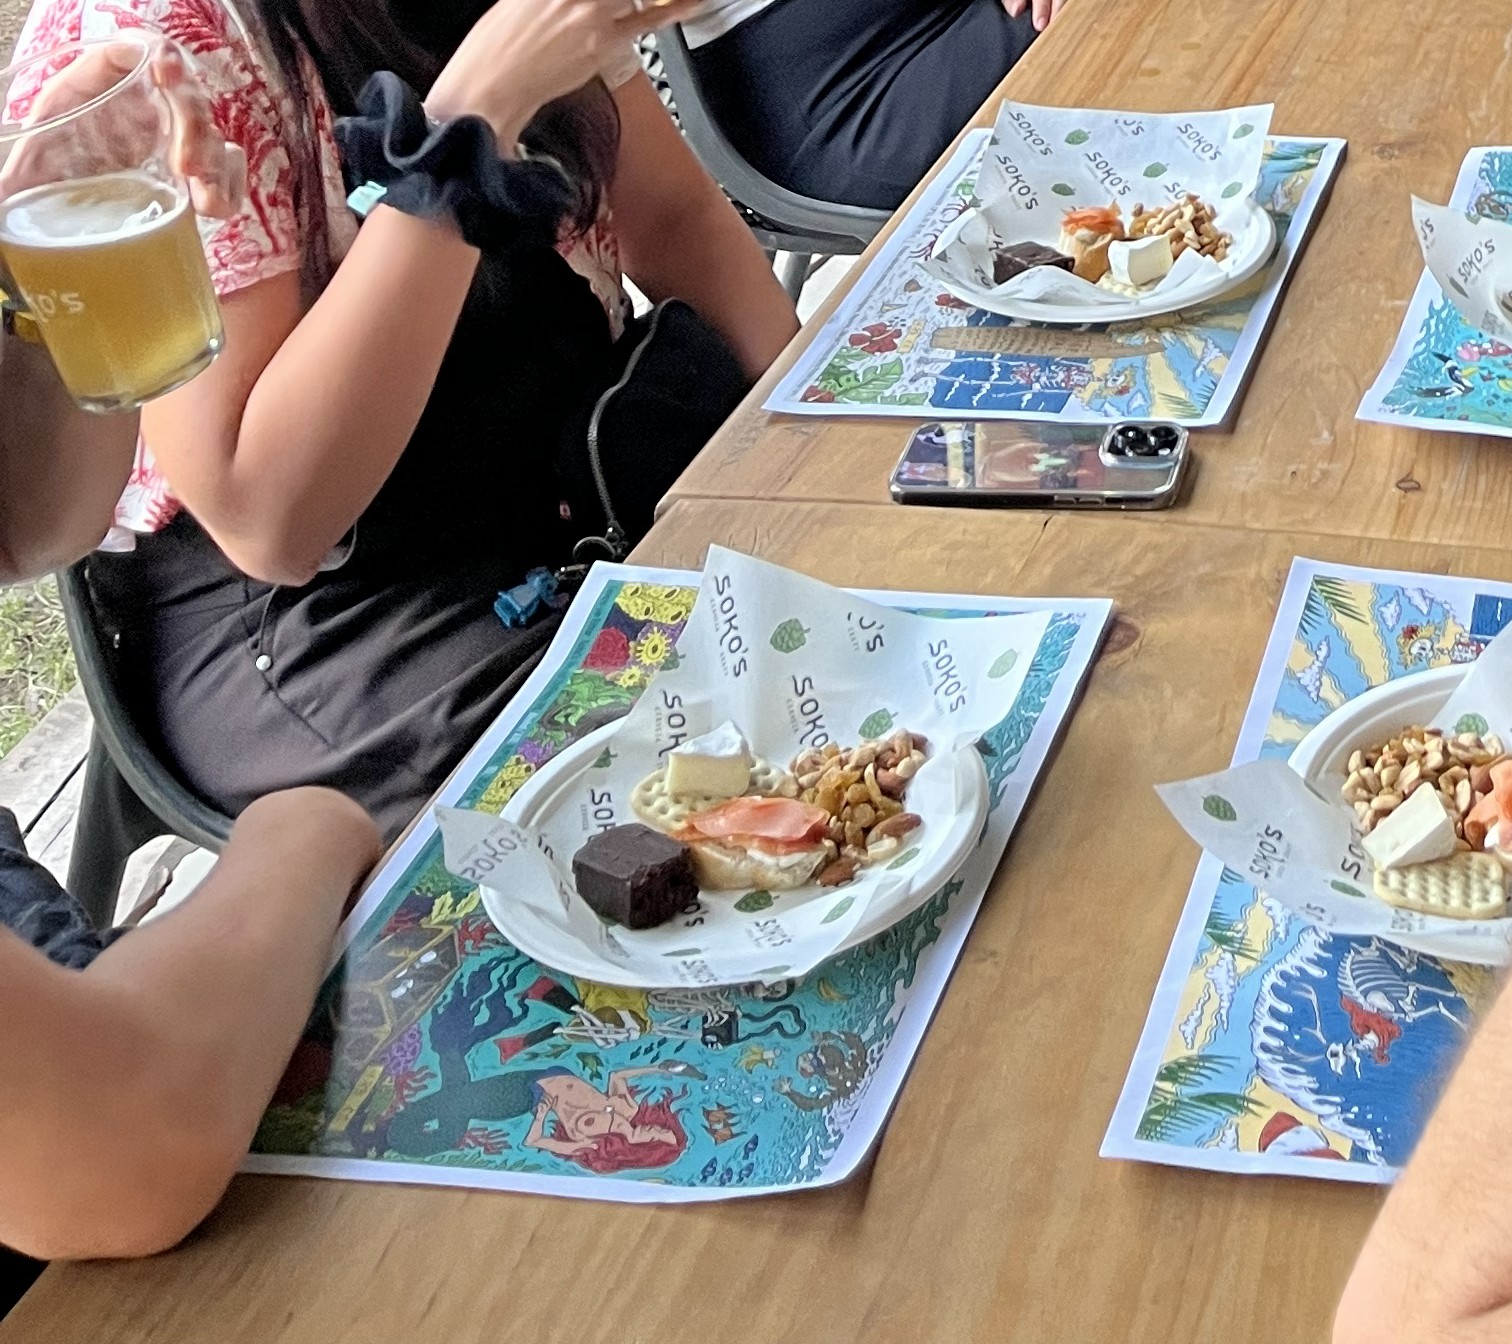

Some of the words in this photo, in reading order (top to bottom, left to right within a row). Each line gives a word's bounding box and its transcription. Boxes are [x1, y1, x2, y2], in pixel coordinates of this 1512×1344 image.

[1008, 110, 1053, 156] SOKO'S
[1177, 123, 1222, 161] SOKO'S
[995, 153, 1038, 210] SOKO'S
[1085, 150, 1132, 197] SOKO'S
[1457, 238, 1495, 284] SOKO'S
[714, 574, 749, 678] SOKO'S
[928, 639, 968, 714] SOKO'S
